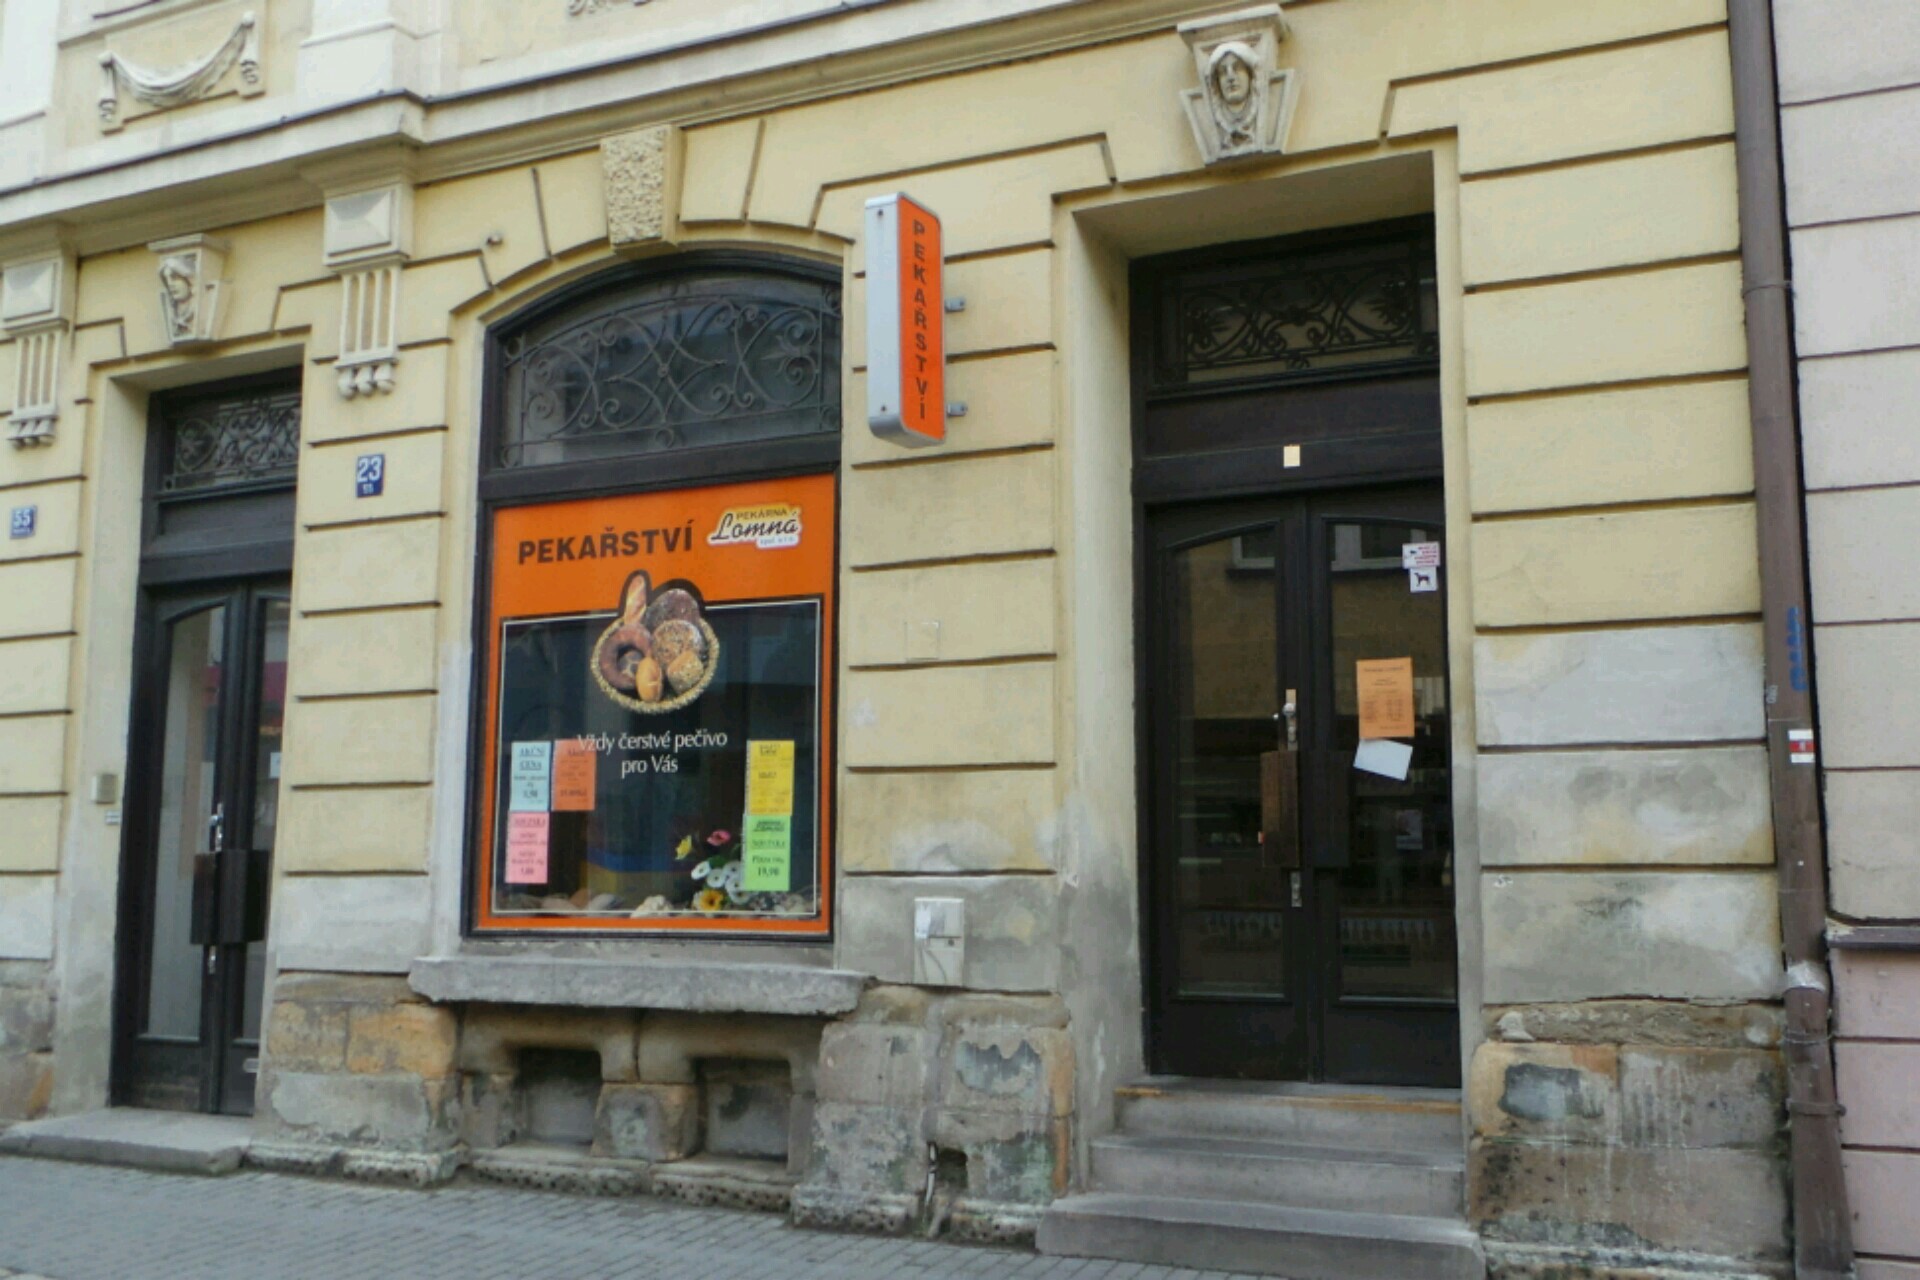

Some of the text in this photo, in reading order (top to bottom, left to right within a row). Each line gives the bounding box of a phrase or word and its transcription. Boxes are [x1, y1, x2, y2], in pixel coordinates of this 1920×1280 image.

[913, 219, 928, 420] PEKAŘSTVÍ
[357, 456, 382, 482] 23
[710, 511, 799, 540] Lomná
[518, 519, 695, 565] PEKAŘSTVÍ
[577, 727, 728, 755] Vždy čerstvé pečivo
[621, 753, 678, 779] pro Vás
